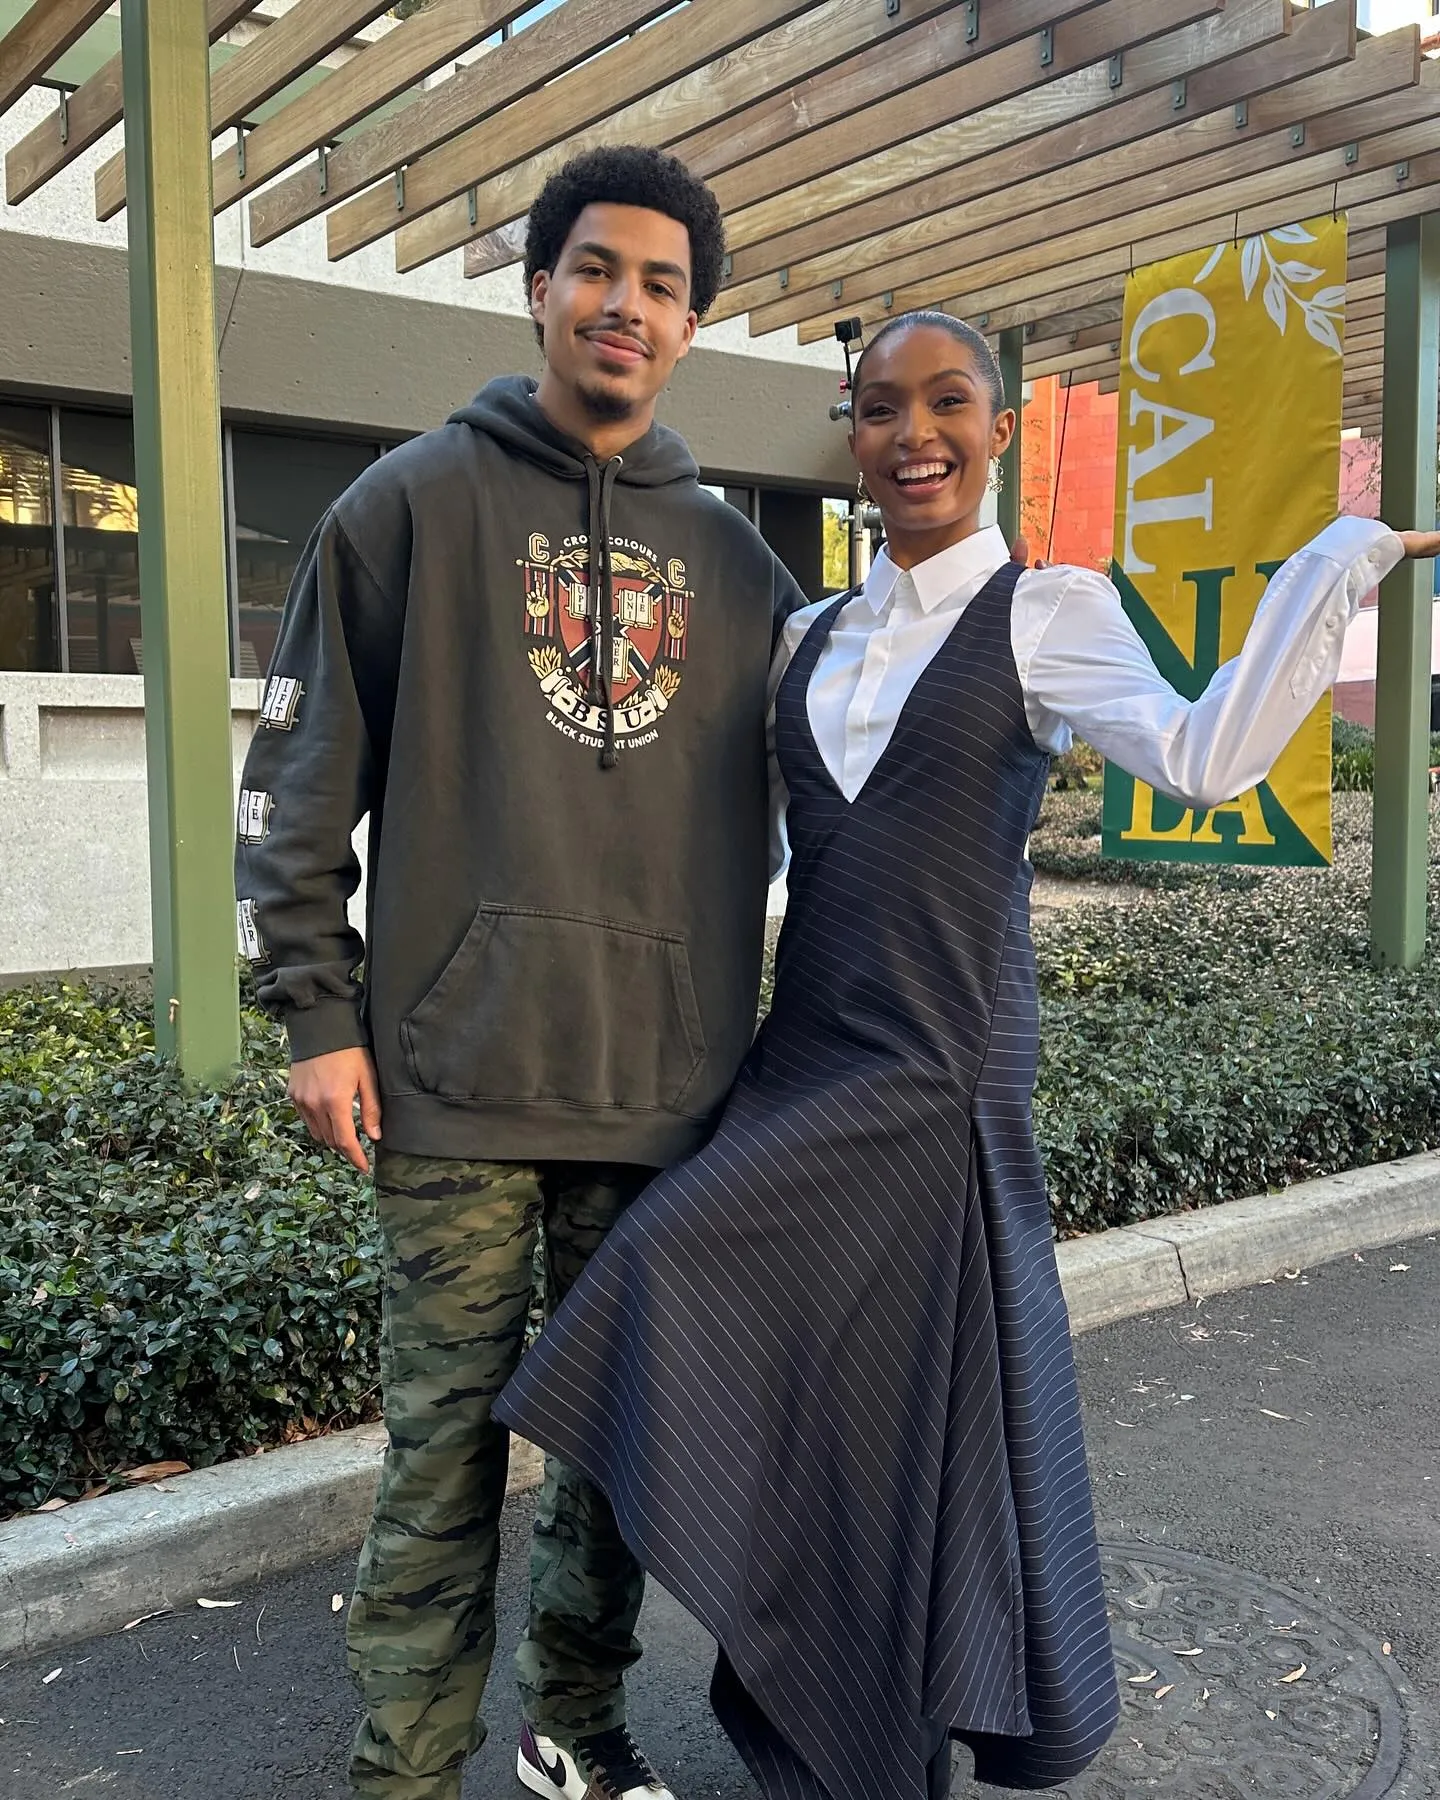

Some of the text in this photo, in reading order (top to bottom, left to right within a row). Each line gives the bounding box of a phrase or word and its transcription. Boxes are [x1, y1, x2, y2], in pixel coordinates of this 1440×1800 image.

[1123, 287, 1216, 575] CAL
[528, 532, 550, 564] C
[608, 536, 658, 563] COLOURS
[667, 558, 686, 588] C
[545, 711, 660, 750] BLACK STUDNT UNION
